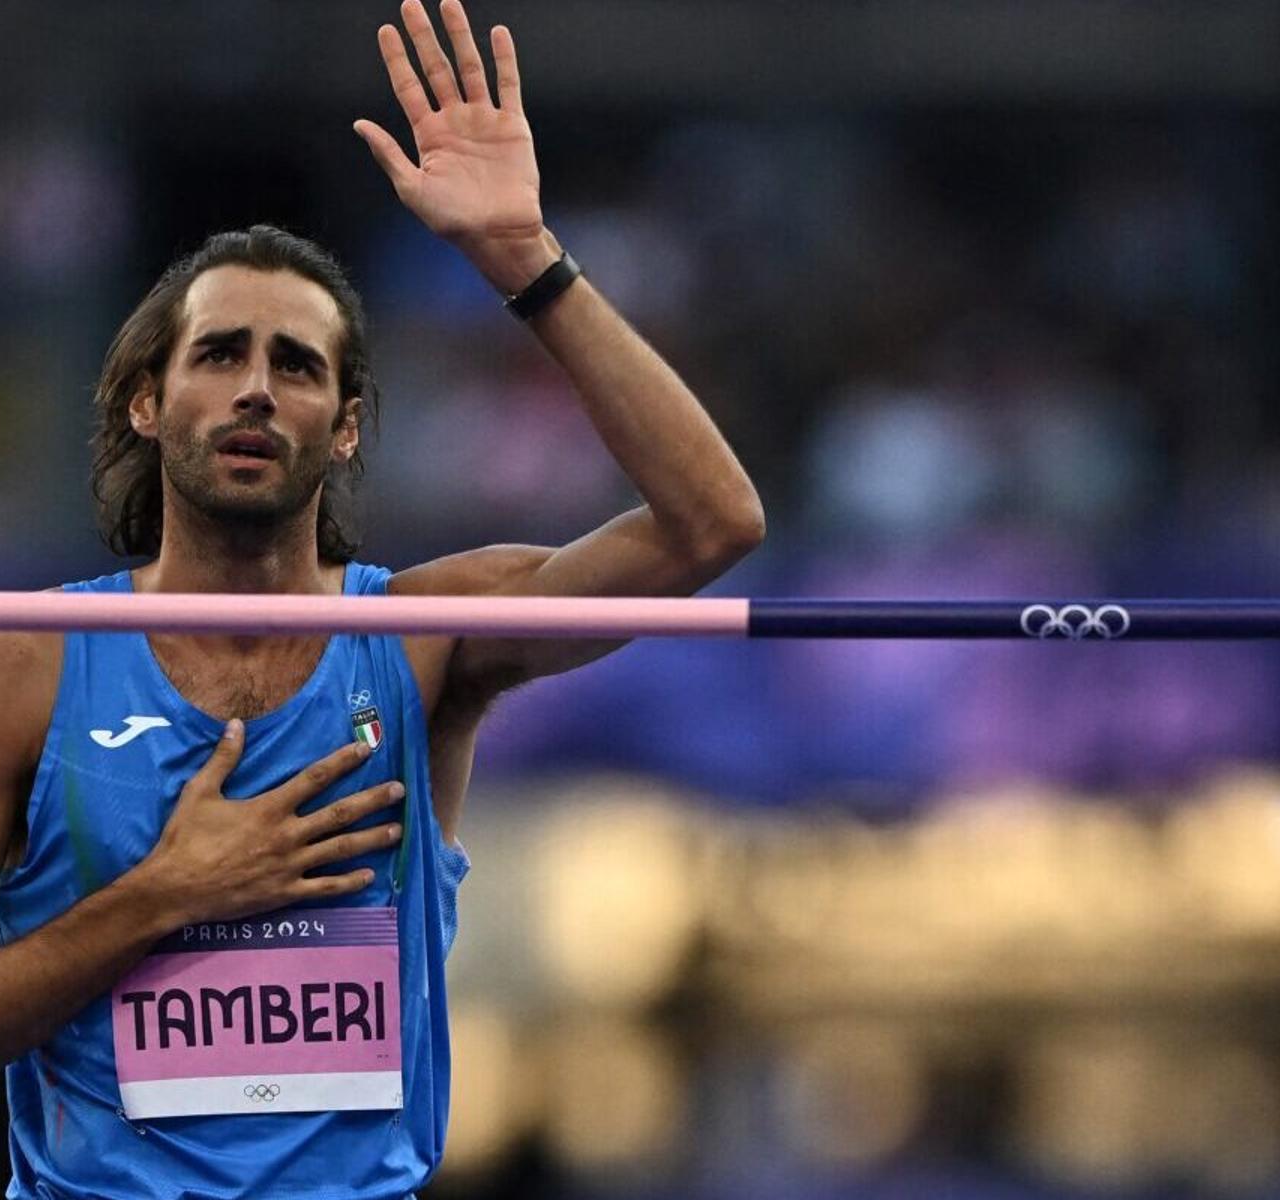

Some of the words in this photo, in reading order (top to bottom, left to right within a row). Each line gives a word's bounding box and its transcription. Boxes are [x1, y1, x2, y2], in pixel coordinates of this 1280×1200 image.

[183, 922, 253, 941] PARIS
[262, 920, 325, 939] 2024
[121, 981, 385, 1050] TAMBERI
